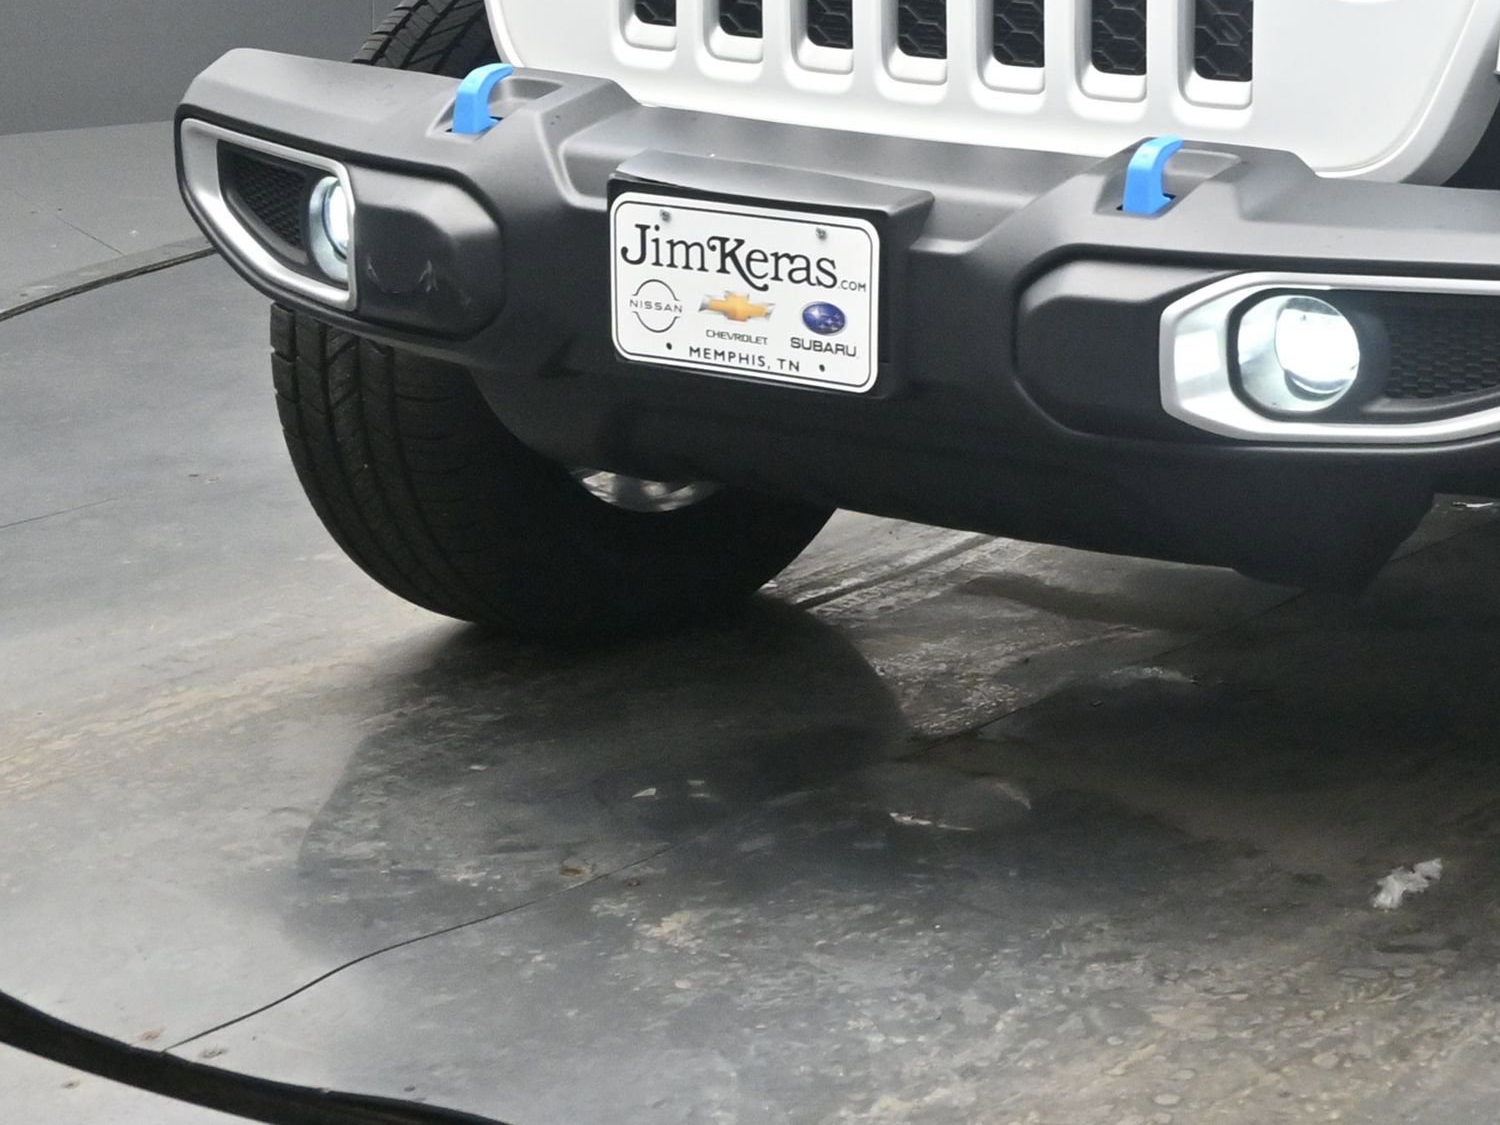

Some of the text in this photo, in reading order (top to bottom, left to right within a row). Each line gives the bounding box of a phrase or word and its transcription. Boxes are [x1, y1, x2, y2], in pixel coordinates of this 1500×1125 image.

[629, 298, 683, 314] NISSAN
[705, 329, 768, 345] CHEVROLET
[790, 337, 857, 357] SUBARU
[689, 346, 800, 372] MEMPHIS, TN
